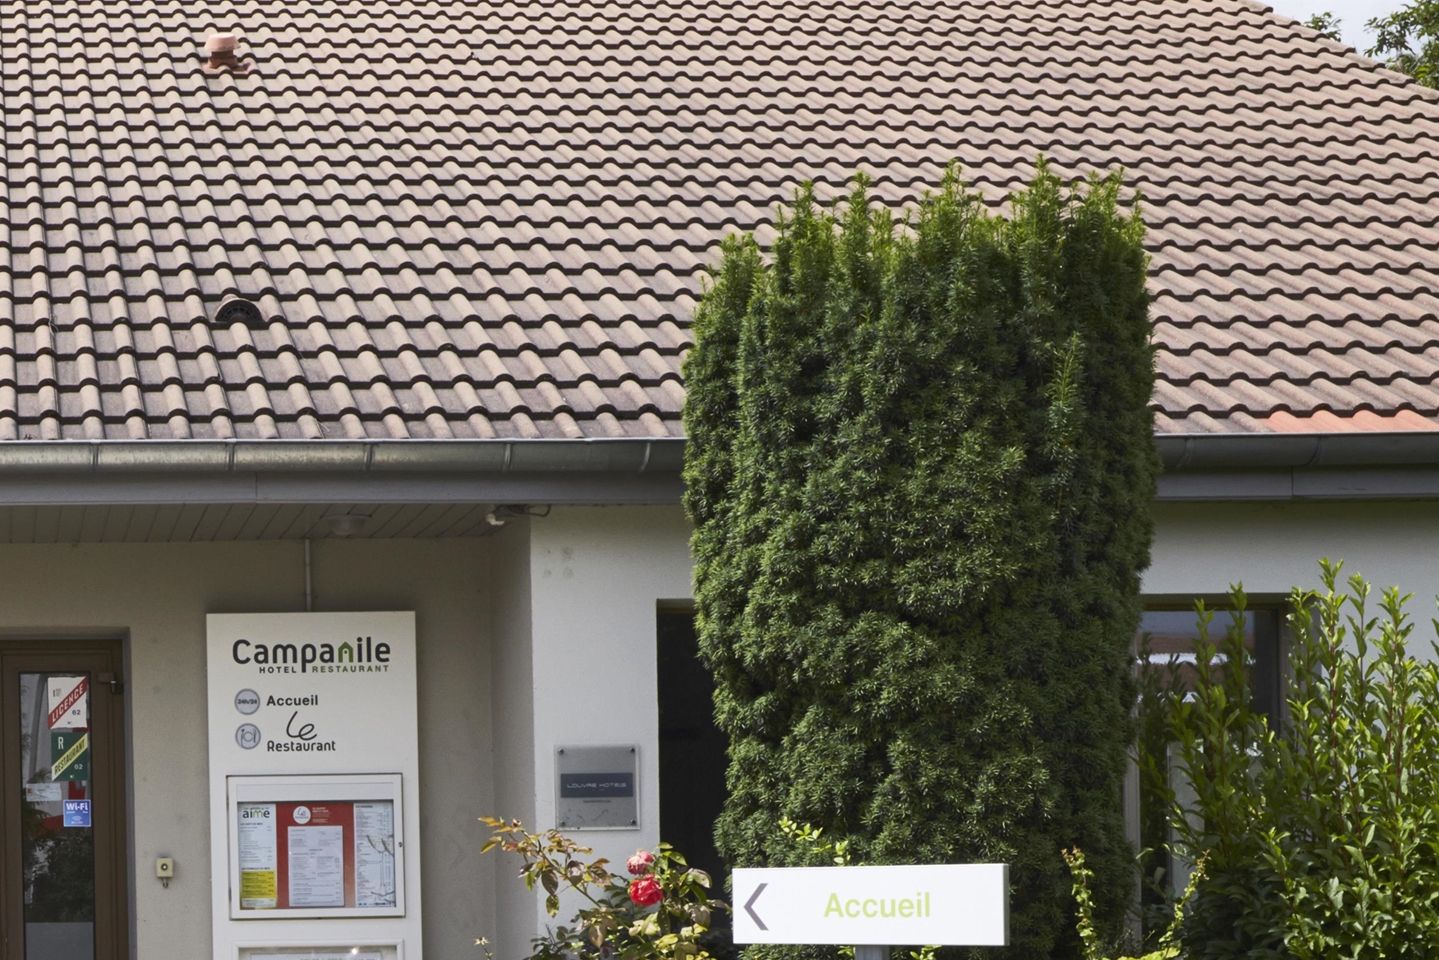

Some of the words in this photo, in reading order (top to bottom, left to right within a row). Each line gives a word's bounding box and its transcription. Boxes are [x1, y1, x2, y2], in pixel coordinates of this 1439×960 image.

[232, 636, 390, 673] Campanile
[259, 666, 297, 674] HOTEL
[312, 664, 389, 673] RESTAURANT
[52, 682, 84, 722] LICENCE
[266, 695, 318, 706] Accueil
[286, 711, 317, 740] Le
[57, 736, 64, 749] R
[267, 740, 336, 752] Restaurant
[54, 738, 86, 773] RESTAURANT
[65, 802, 88, 811] Wi-Fi
[823, 891, 931, 918] Accueil
